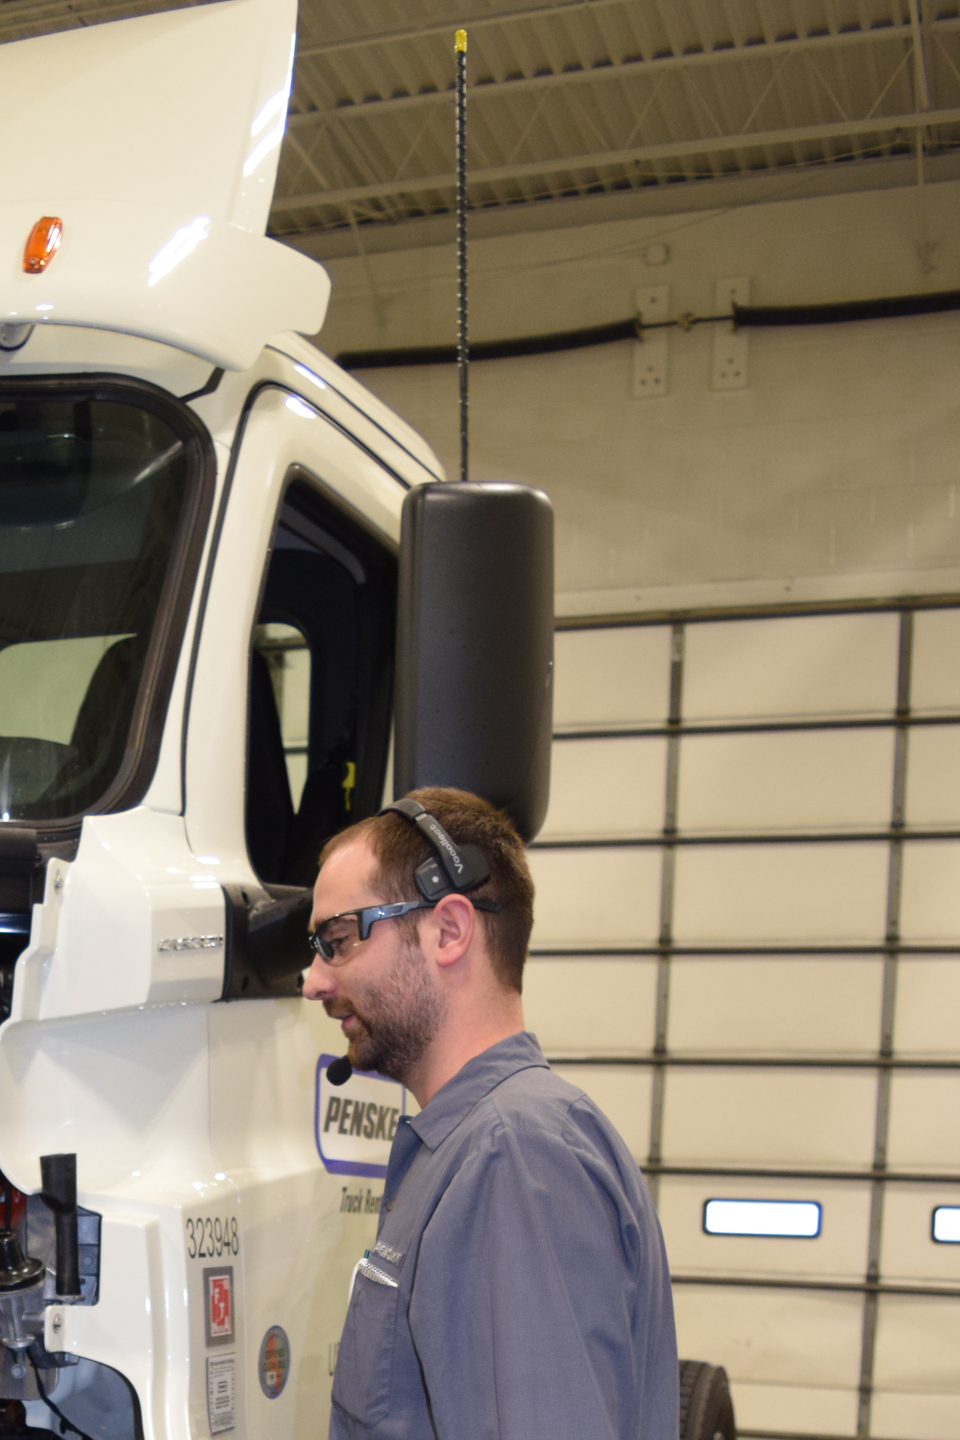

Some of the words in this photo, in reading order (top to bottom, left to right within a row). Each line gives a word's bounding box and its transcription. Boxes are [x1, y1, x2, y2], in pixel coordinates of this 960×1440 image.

[429, 823, 464, 874] Vocollect
[323, 1096, 400, 1142] PENSKE
[340, 1186, 363, 1214] Truck
[186, 1217, 239, 1259] 323948
